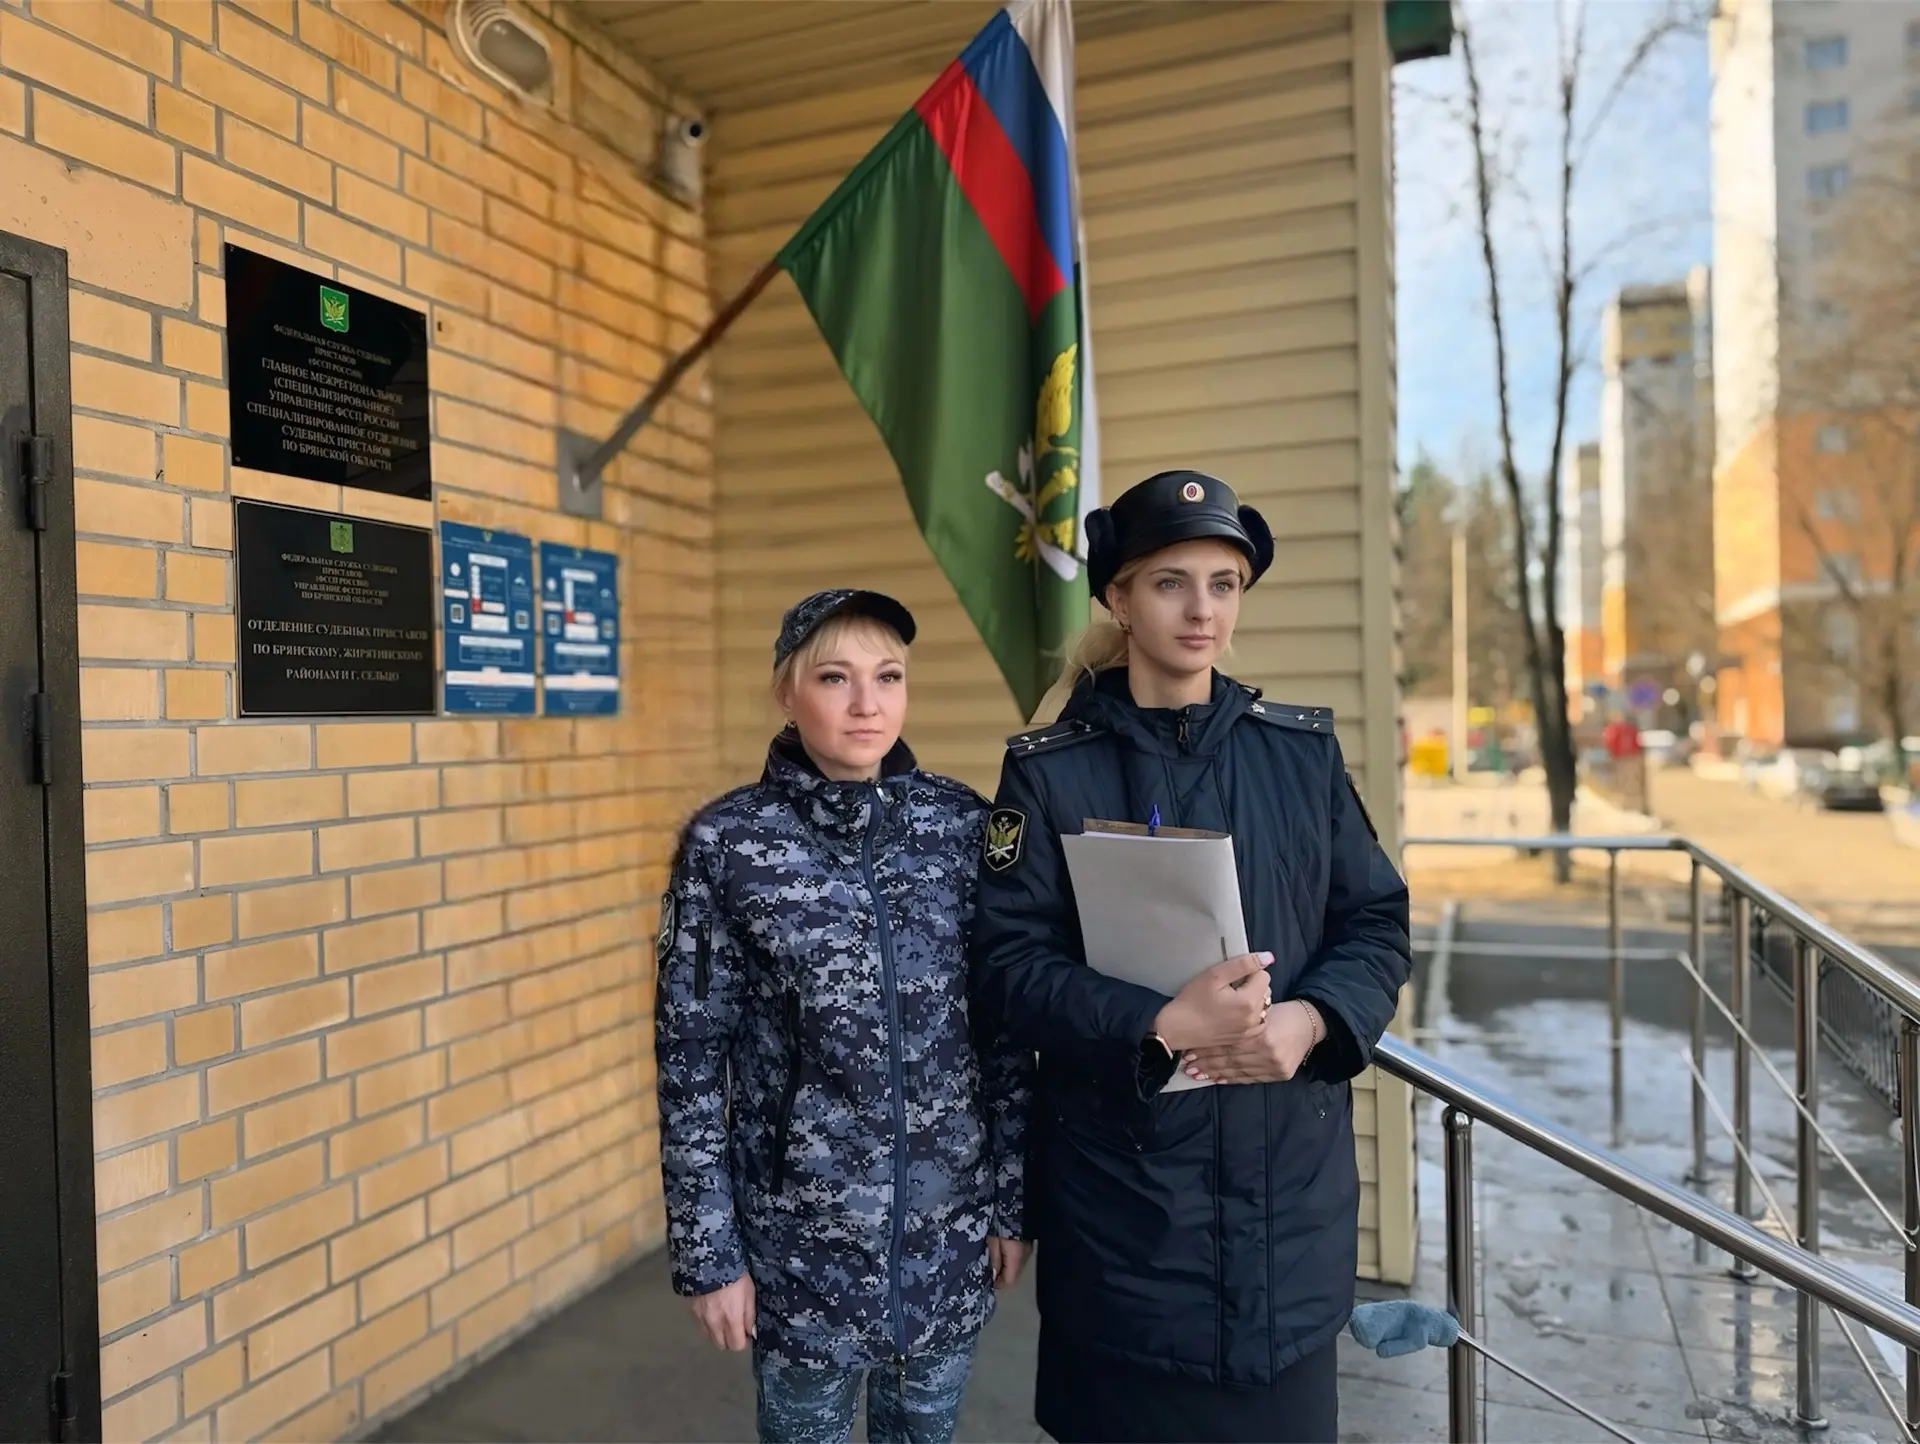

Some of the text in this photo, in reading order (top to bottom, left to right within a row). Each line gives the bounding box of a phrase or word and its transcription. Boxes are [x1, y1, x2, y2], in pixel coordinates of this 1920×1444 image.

[262, 358, 404, 405] ГЛАВНОЕ МЕЖРЕГИОНАЛЬНОЕ
[274, 377, 395, 417] (СПЕЦИАЛИЗИРОВАННОЕ)
[247, 402, 419, 449] СПЕЦИАЛИЗИРОВАННОЕ ОТДЕЛЕНИЕ
[269, 390, 399, 430] УПРАВЛЕНИЕ ФССП РОССИИ
[282, 424, 391, 457] СУДЕБНЫХ ПРИСТАВОВ
[283, 440, 392, 471] ПО БРЯНСКОЙ ОБЛАСТИ
[281, 553, 333, 565] ФЕДЕРАЛЬНАЯ
[302, 591, 312, 599] ПО
[248, 619, 428, 640] ОТДЕЛЕНИЕ СУДЕБНЫХ ПРИСТАВОВ
[253, 643, 423, 661] ПО БРЯНСКОМУ, ЖИРЯТИНСКОМУ
[286, 667, 399, 681] РАЙОНАМ И Г. СЕЛЬЦО
